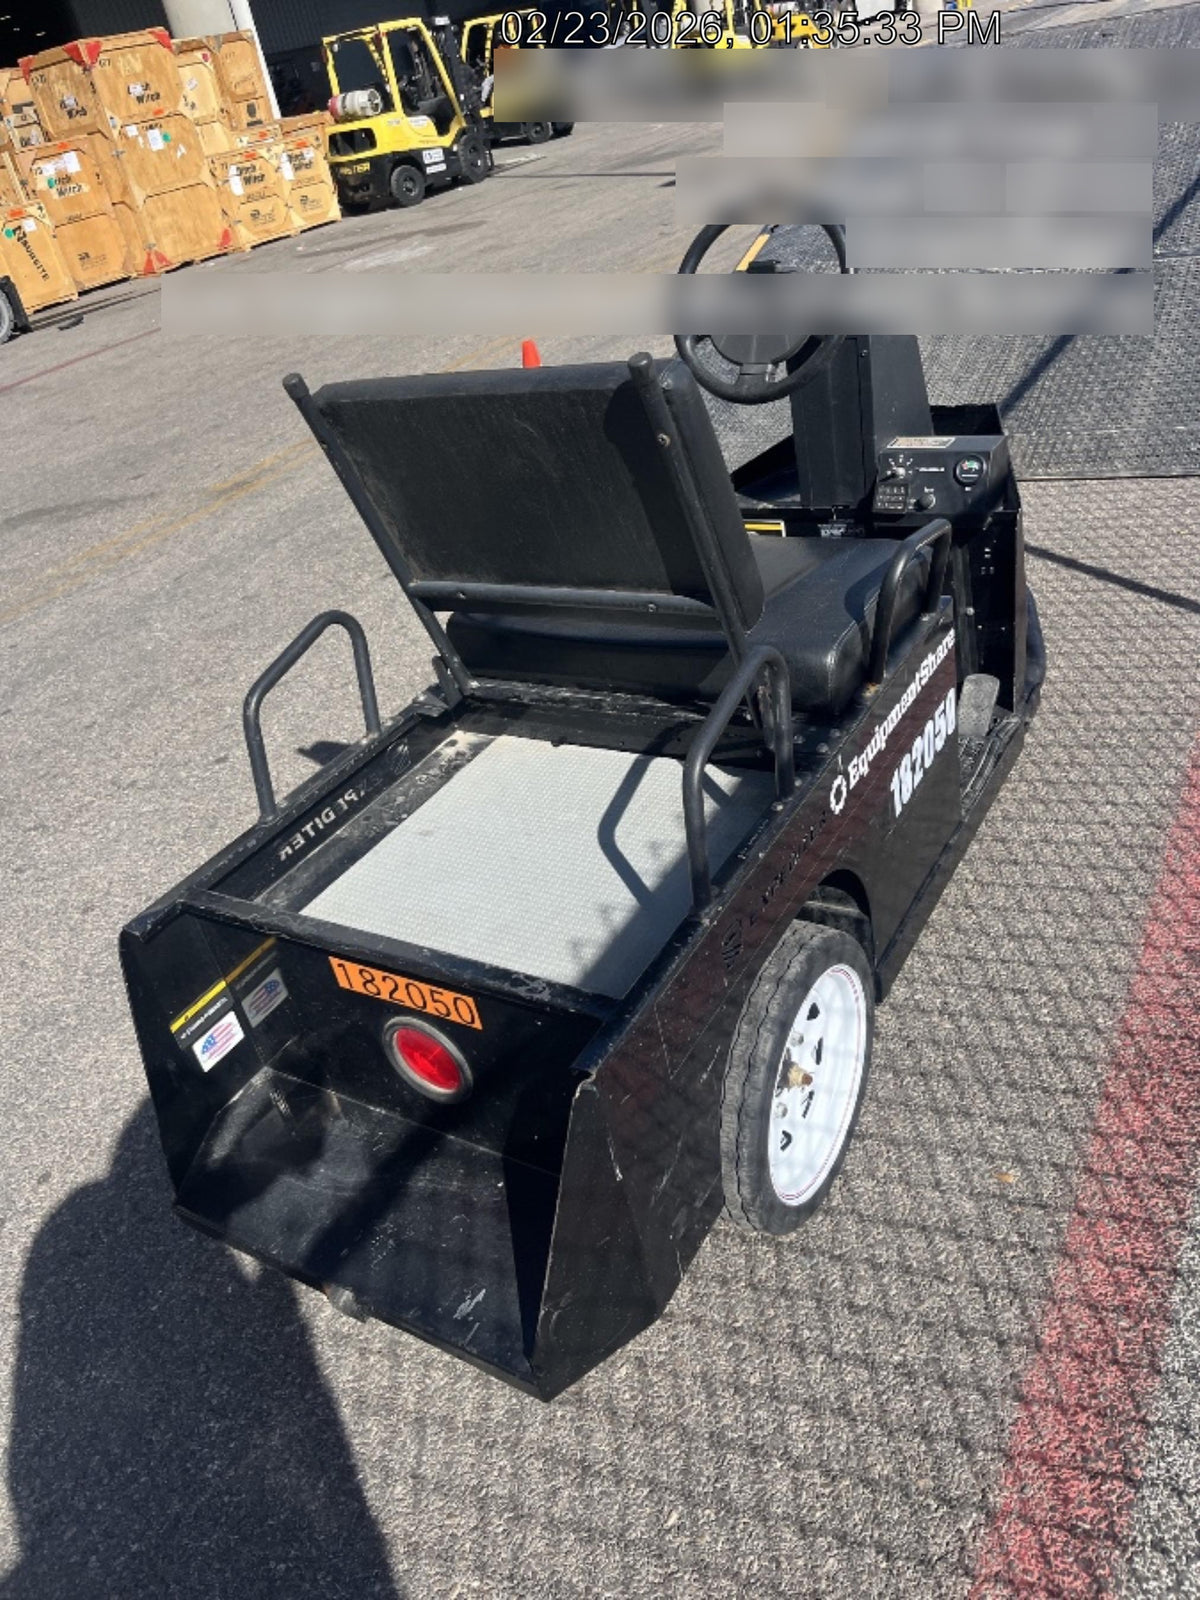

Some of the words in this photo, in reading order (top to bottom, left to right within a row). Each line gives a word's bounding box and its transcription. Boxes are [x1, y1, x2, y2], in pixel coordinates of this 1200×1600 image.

[847, 628, 956, 790] EquipmentShare
[890, 687, 957, 818] 182050
[337, 962, 477, 1026] 182050
